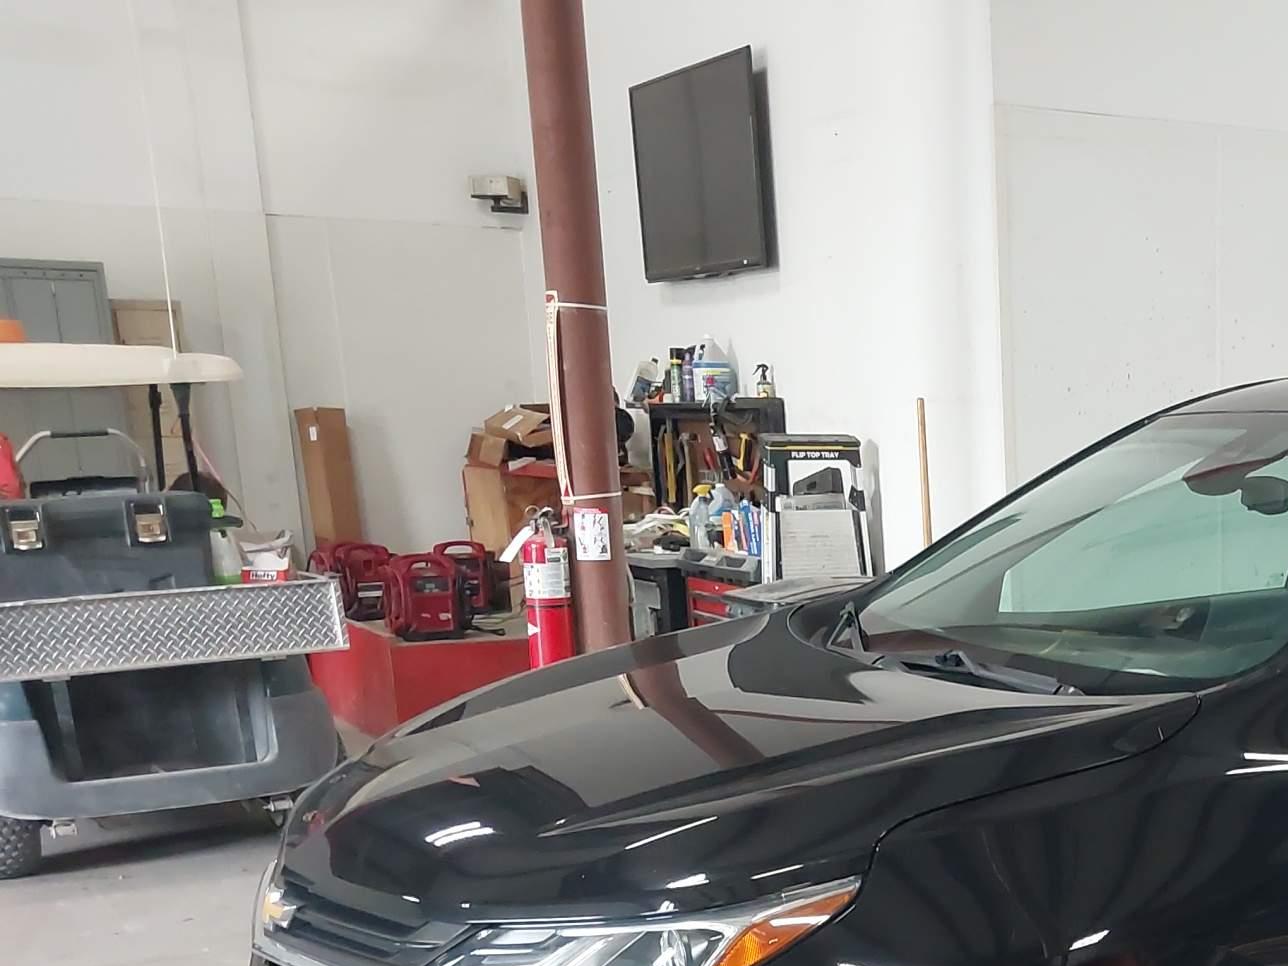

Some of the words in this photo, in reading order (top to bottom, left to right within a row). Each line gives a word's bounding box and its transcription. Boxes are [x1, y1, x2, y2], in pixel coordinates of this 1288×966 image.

[791, 451, 805, 459] FLIP
[806, 451, 820, 459] TOP
[820, 451, 839, 459] TRAY
